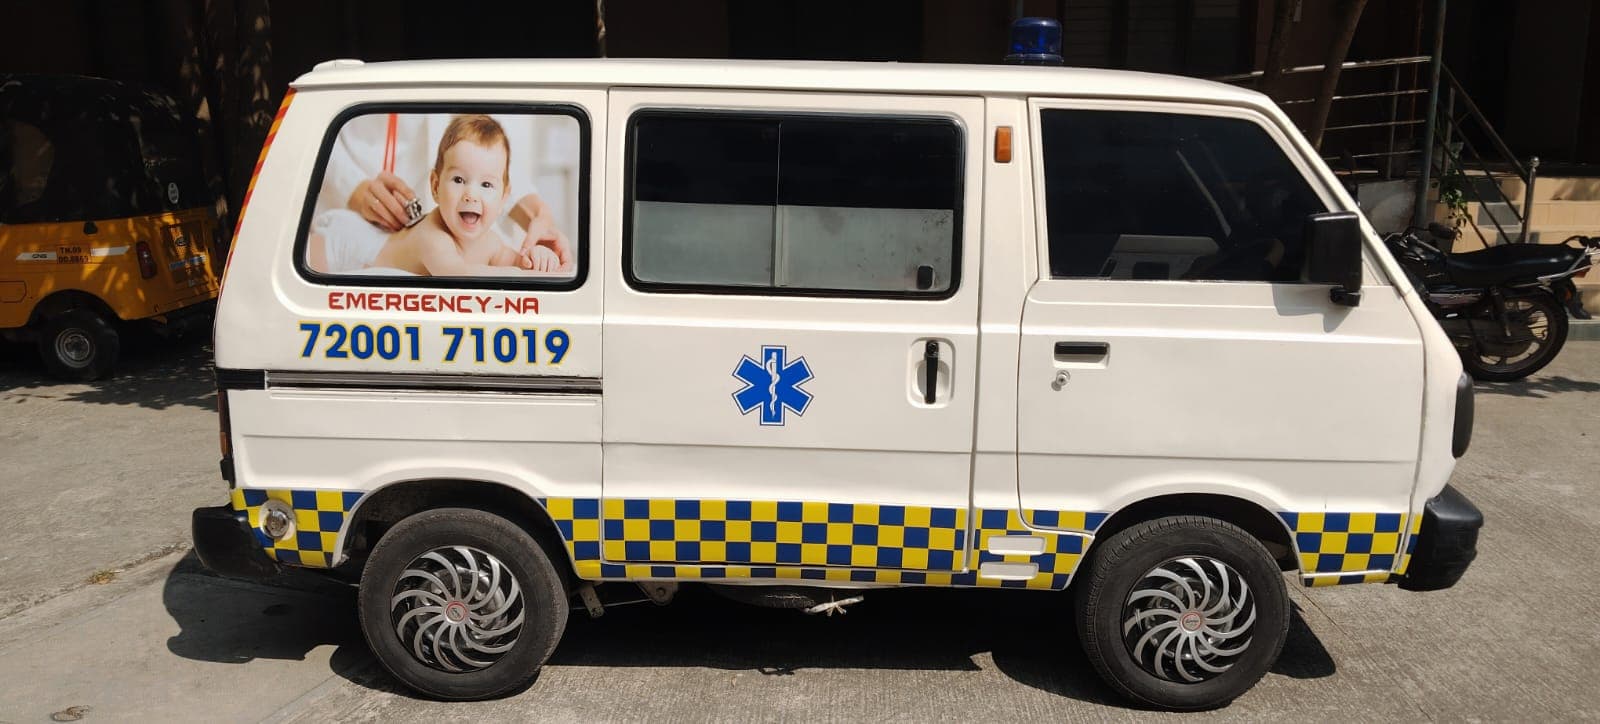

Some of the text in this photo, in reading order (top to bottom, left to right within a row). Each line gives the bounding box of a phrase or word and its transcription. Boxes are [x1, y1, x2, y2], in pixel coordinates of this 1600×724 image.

[328, 292, 539, 314] EMERGENCY-NA
[299, 322, 570, 364] 72001 71019
